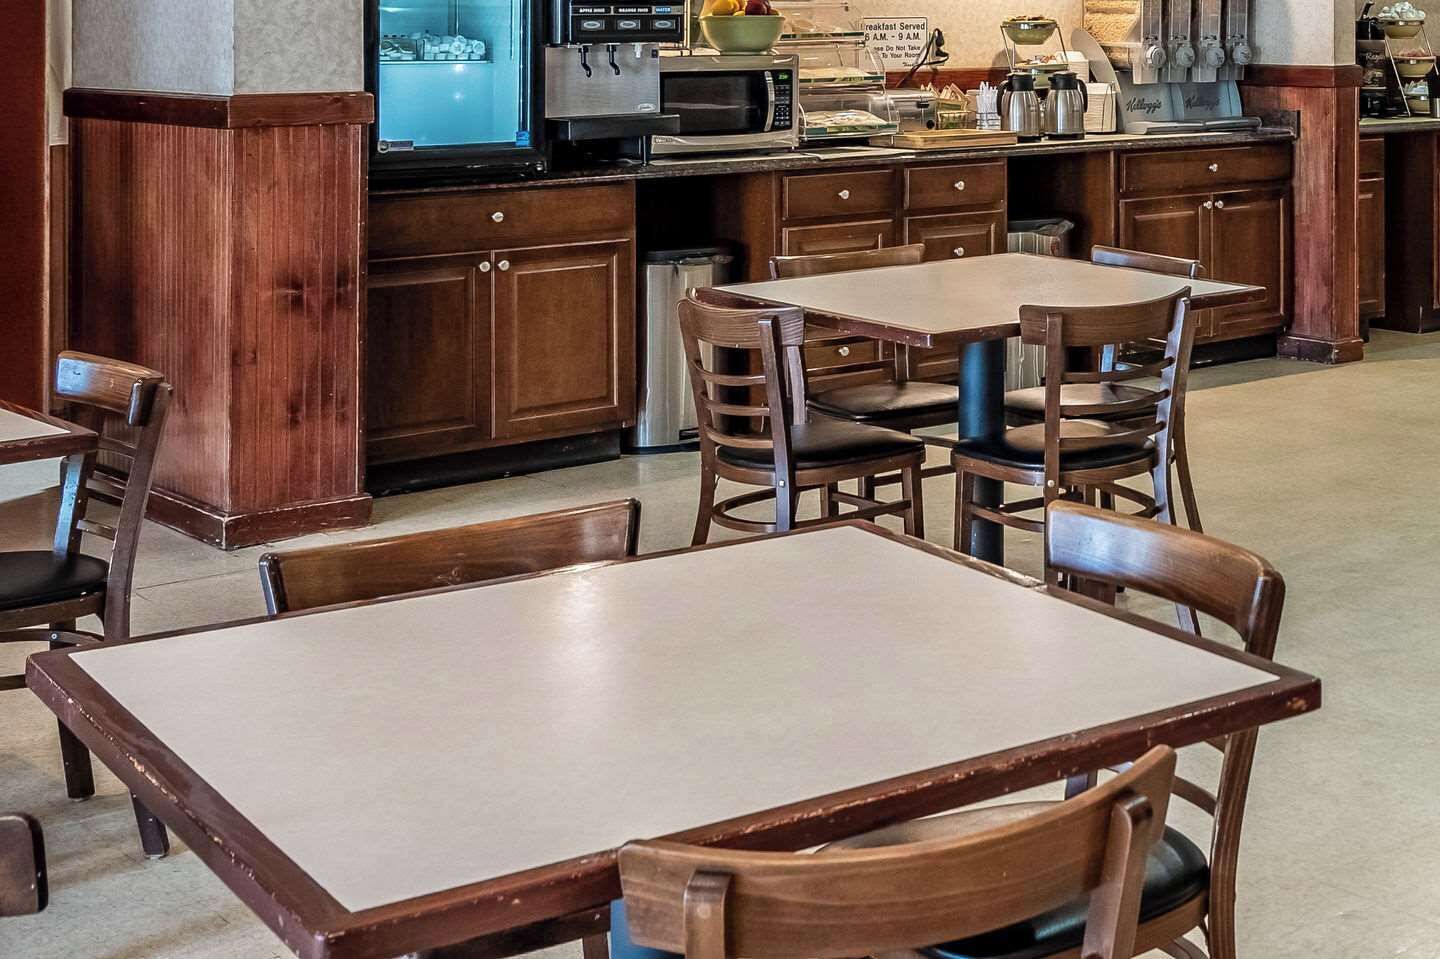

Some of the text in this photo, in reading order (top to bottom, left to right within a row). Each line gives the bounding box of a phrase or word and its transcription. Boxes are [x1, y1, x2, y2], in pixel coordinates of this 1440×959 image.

[862, 22, 925, 31] reakfast Served
[865, 32, 870, 41] 6
[898, 32, 904, 40] 9
[1126, 96, 1162, 114] Kellogg's
